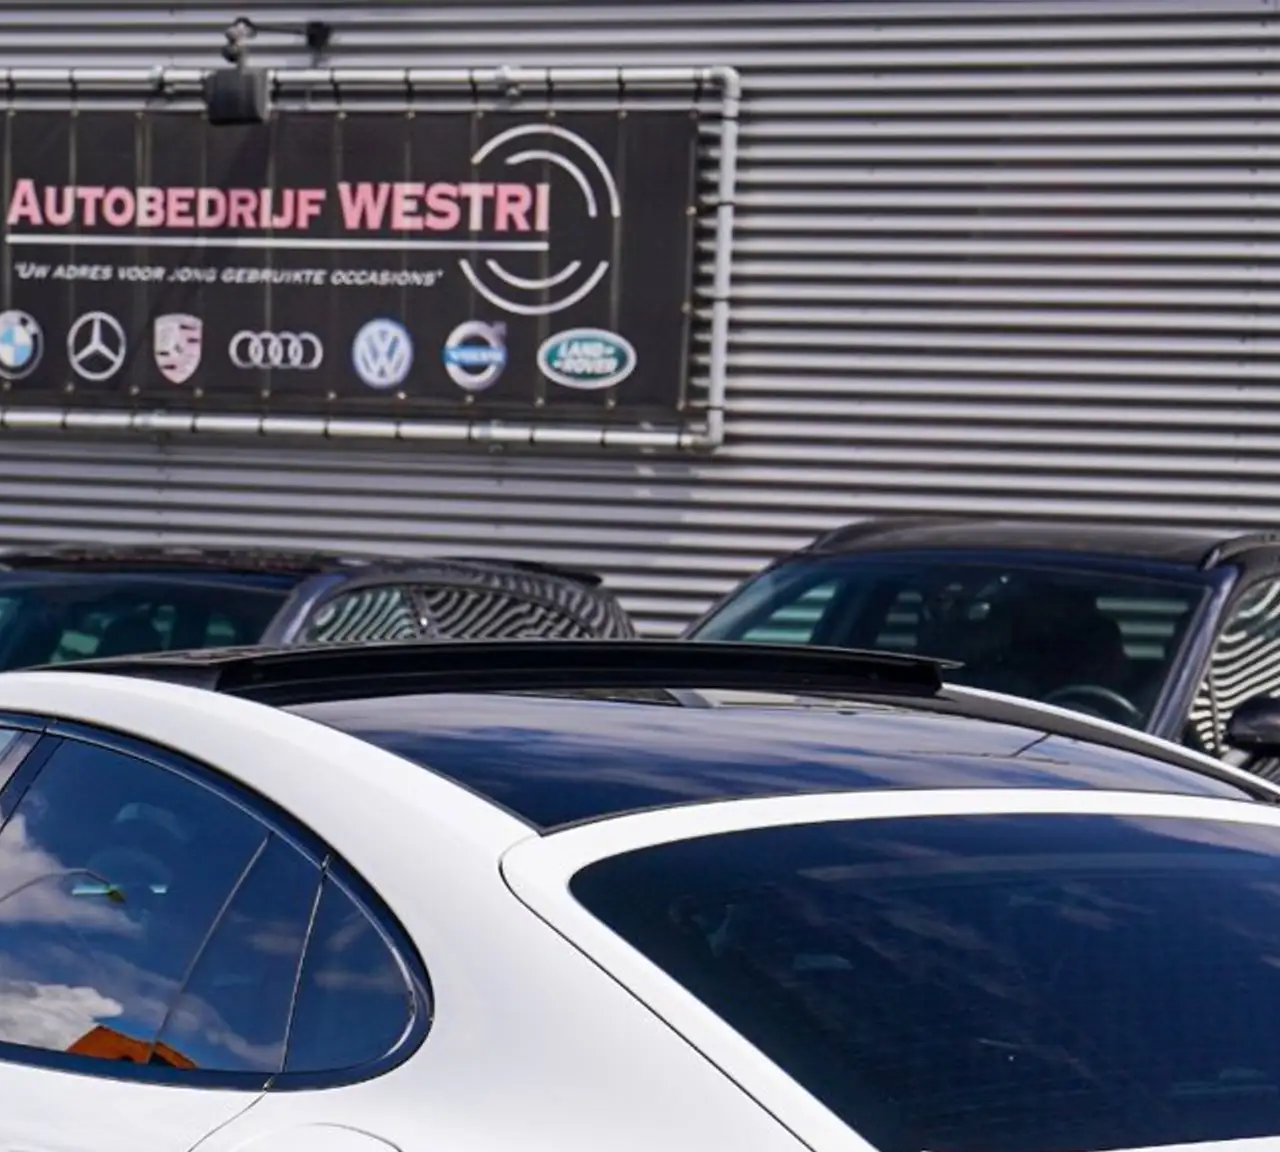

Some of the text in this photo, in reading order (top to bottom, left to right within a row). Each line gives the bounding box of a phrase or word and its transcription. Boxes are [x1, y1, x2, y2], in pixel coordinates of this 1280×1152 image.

[6, 178, 550, 232] AUTOBEDRIJF WESTRI
[51, 264, 114, 281] ADRES
[118, 266, 166, 281] VOOR
[221, 267, 328, 286] GEBRUIKTE
